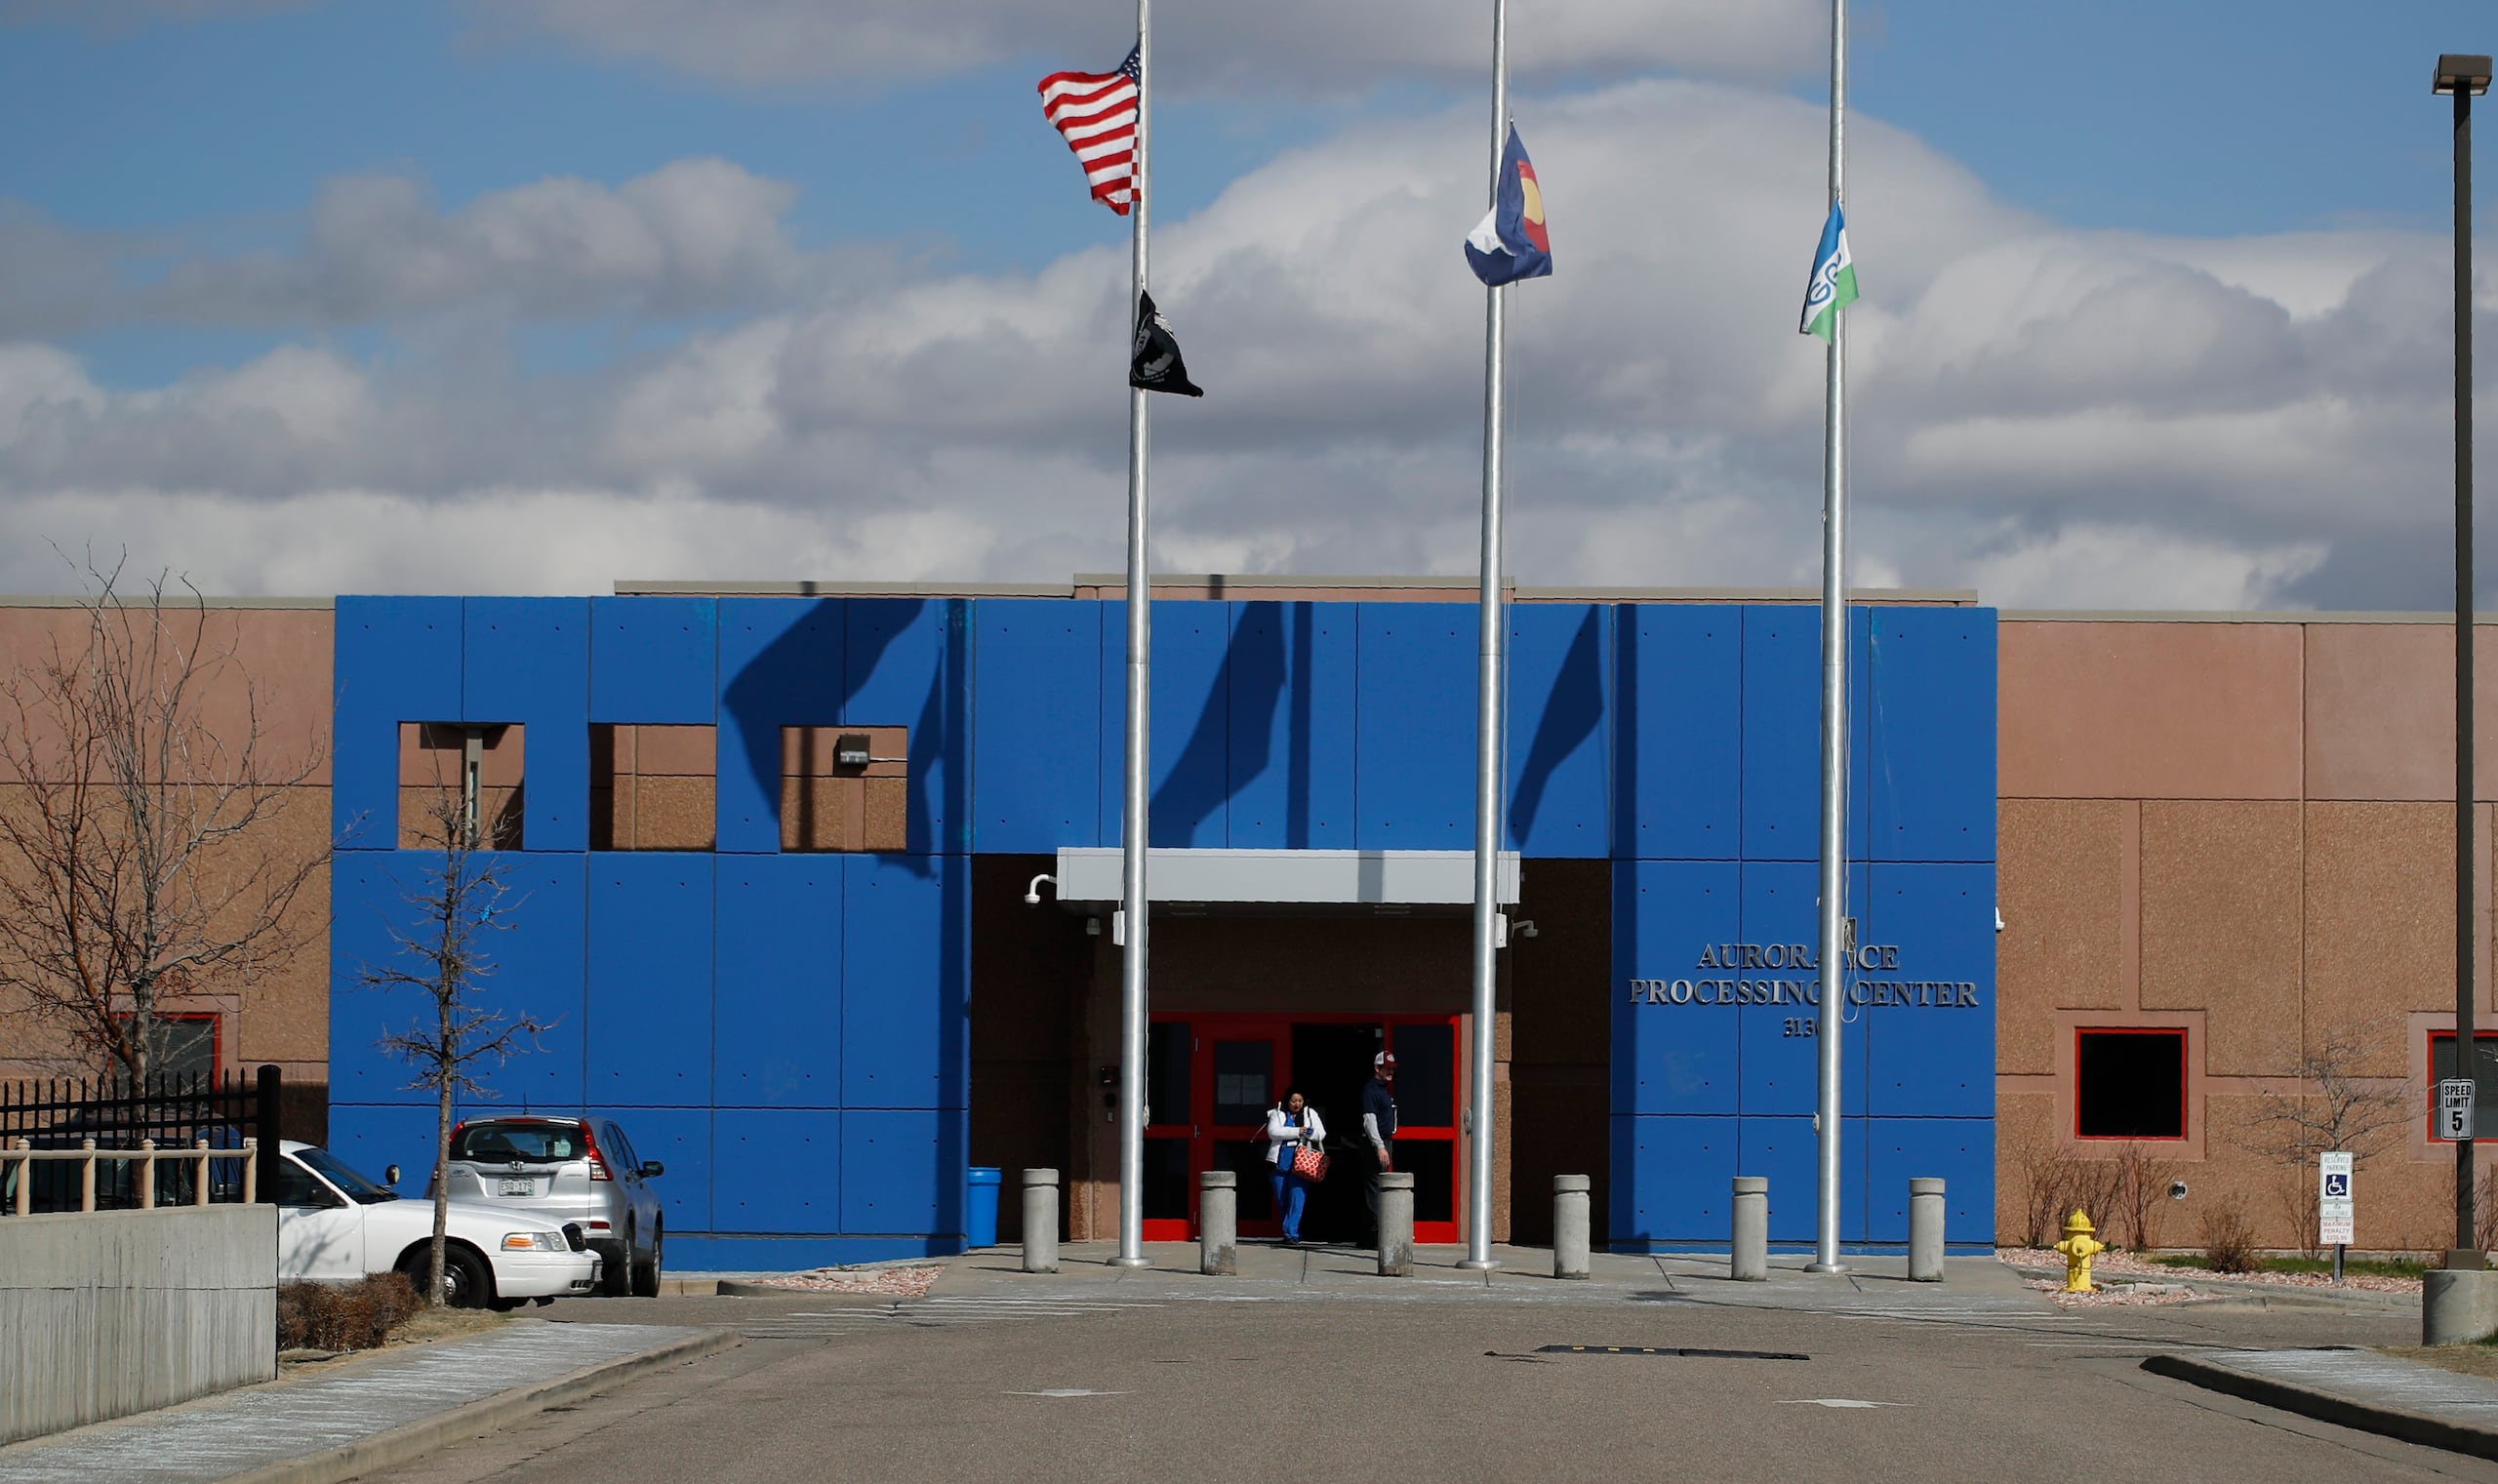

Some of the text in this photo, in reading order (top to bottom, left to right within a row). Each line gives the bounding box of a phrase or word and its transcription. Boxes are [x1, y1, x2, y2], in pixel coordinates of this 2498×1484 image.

[1849, 981, 1979, 1007] CENTER
[1783, 1017, 1820, 1037] 313
[2444, 1085, 2472, 1096] SPEED
[2445, 1098, 2470, 1108] LIMIT
[2451, 1110, 2463, 1132] 5
